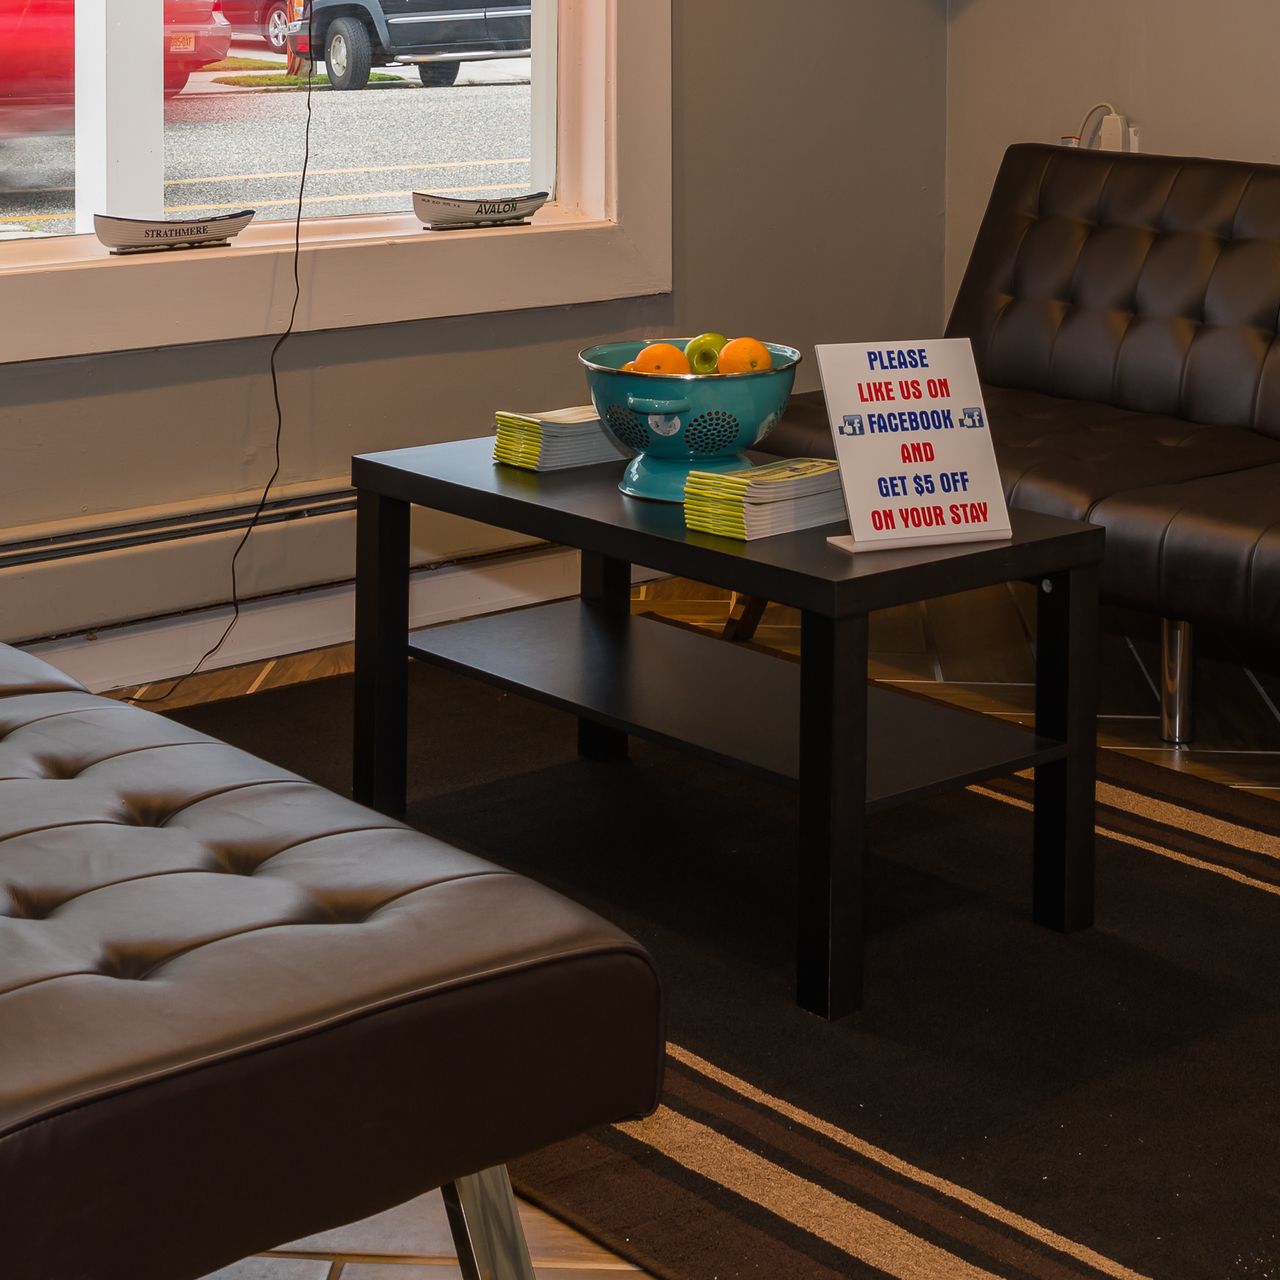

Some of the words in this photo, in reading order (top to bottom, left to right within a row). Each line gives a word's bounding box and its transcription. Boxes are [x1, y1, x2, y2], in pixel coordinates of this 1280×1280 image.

[475, 202, 518, 216] AVALON
[144, 224, 209, 238] STRATHMERE
[867, 348, 929, 371] PLEASE
[857, 381, 896, 403] LIKE
[898, 379, 923, 400] US
[926, 378, 951, 399] ON
[867, 408, 955, 434] FACEBOOK
[900, 441, 935, 464] AND
[877, 475, 909, 498] GET
[913, 472, 936, 497] $5
[939, 471, 970, 493] OFF
[871, 509, 896, 531] ON
[898, 505, 946, 529] YOUR
[949, 502, 989, 525] STAY
